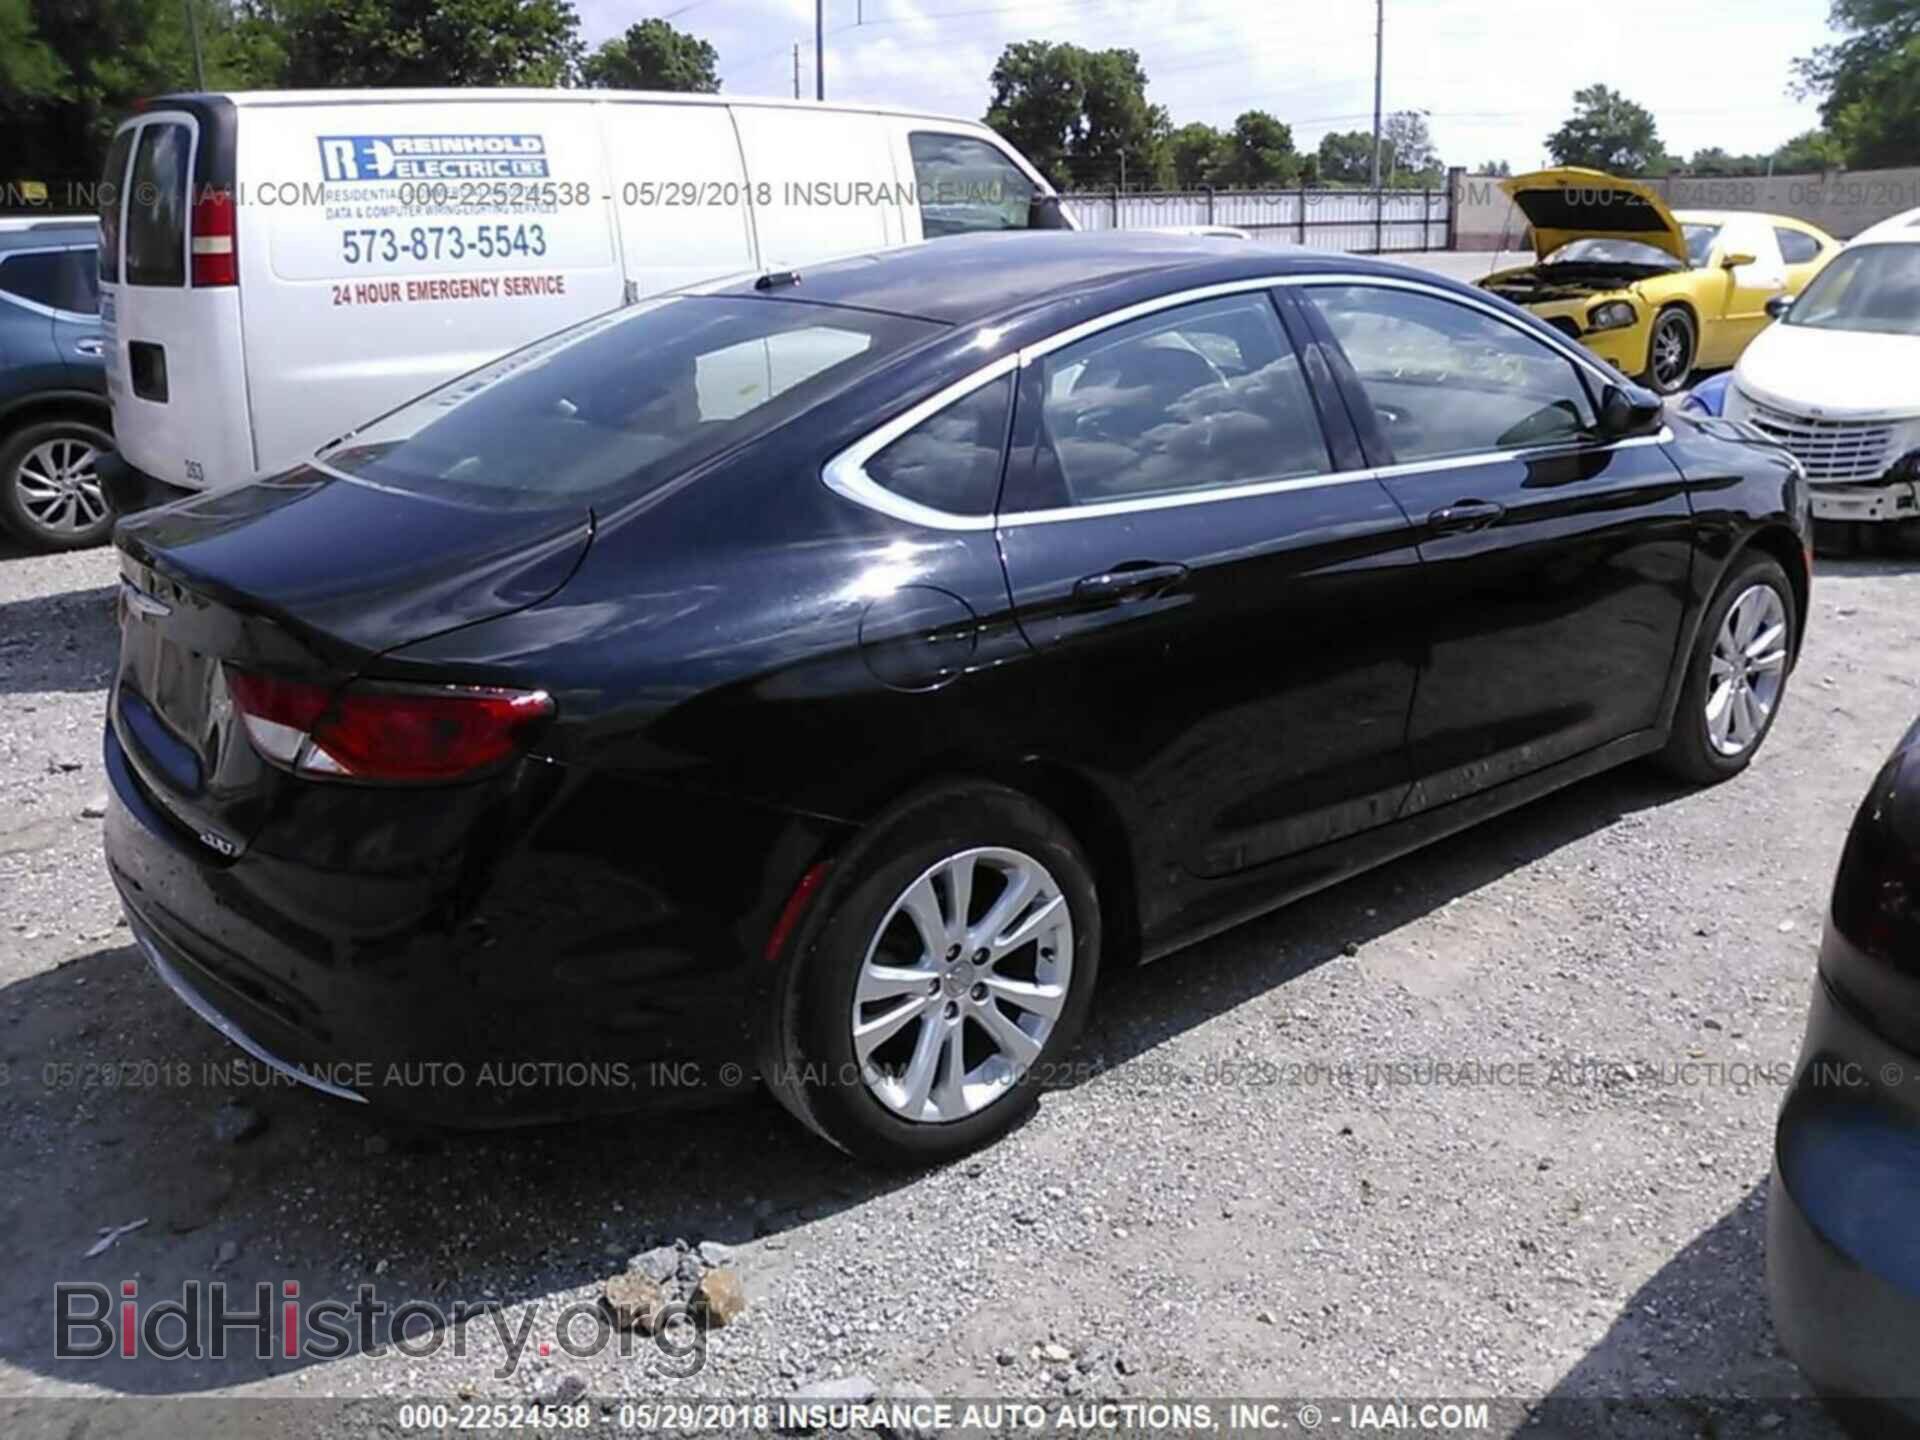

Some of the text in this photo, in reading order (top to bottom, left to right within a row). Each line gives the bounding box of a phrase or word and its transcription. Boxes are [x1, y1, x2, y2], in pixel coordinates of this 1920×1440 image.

[392, 137, 543, 153] REINHOLD
[398, 160, 510, 178] ELECTRIC
[343, 225, 547, 264] 573-873-5543
[332, 275, 565, 306] 24 HOUR EMERGENCY SERVICE
